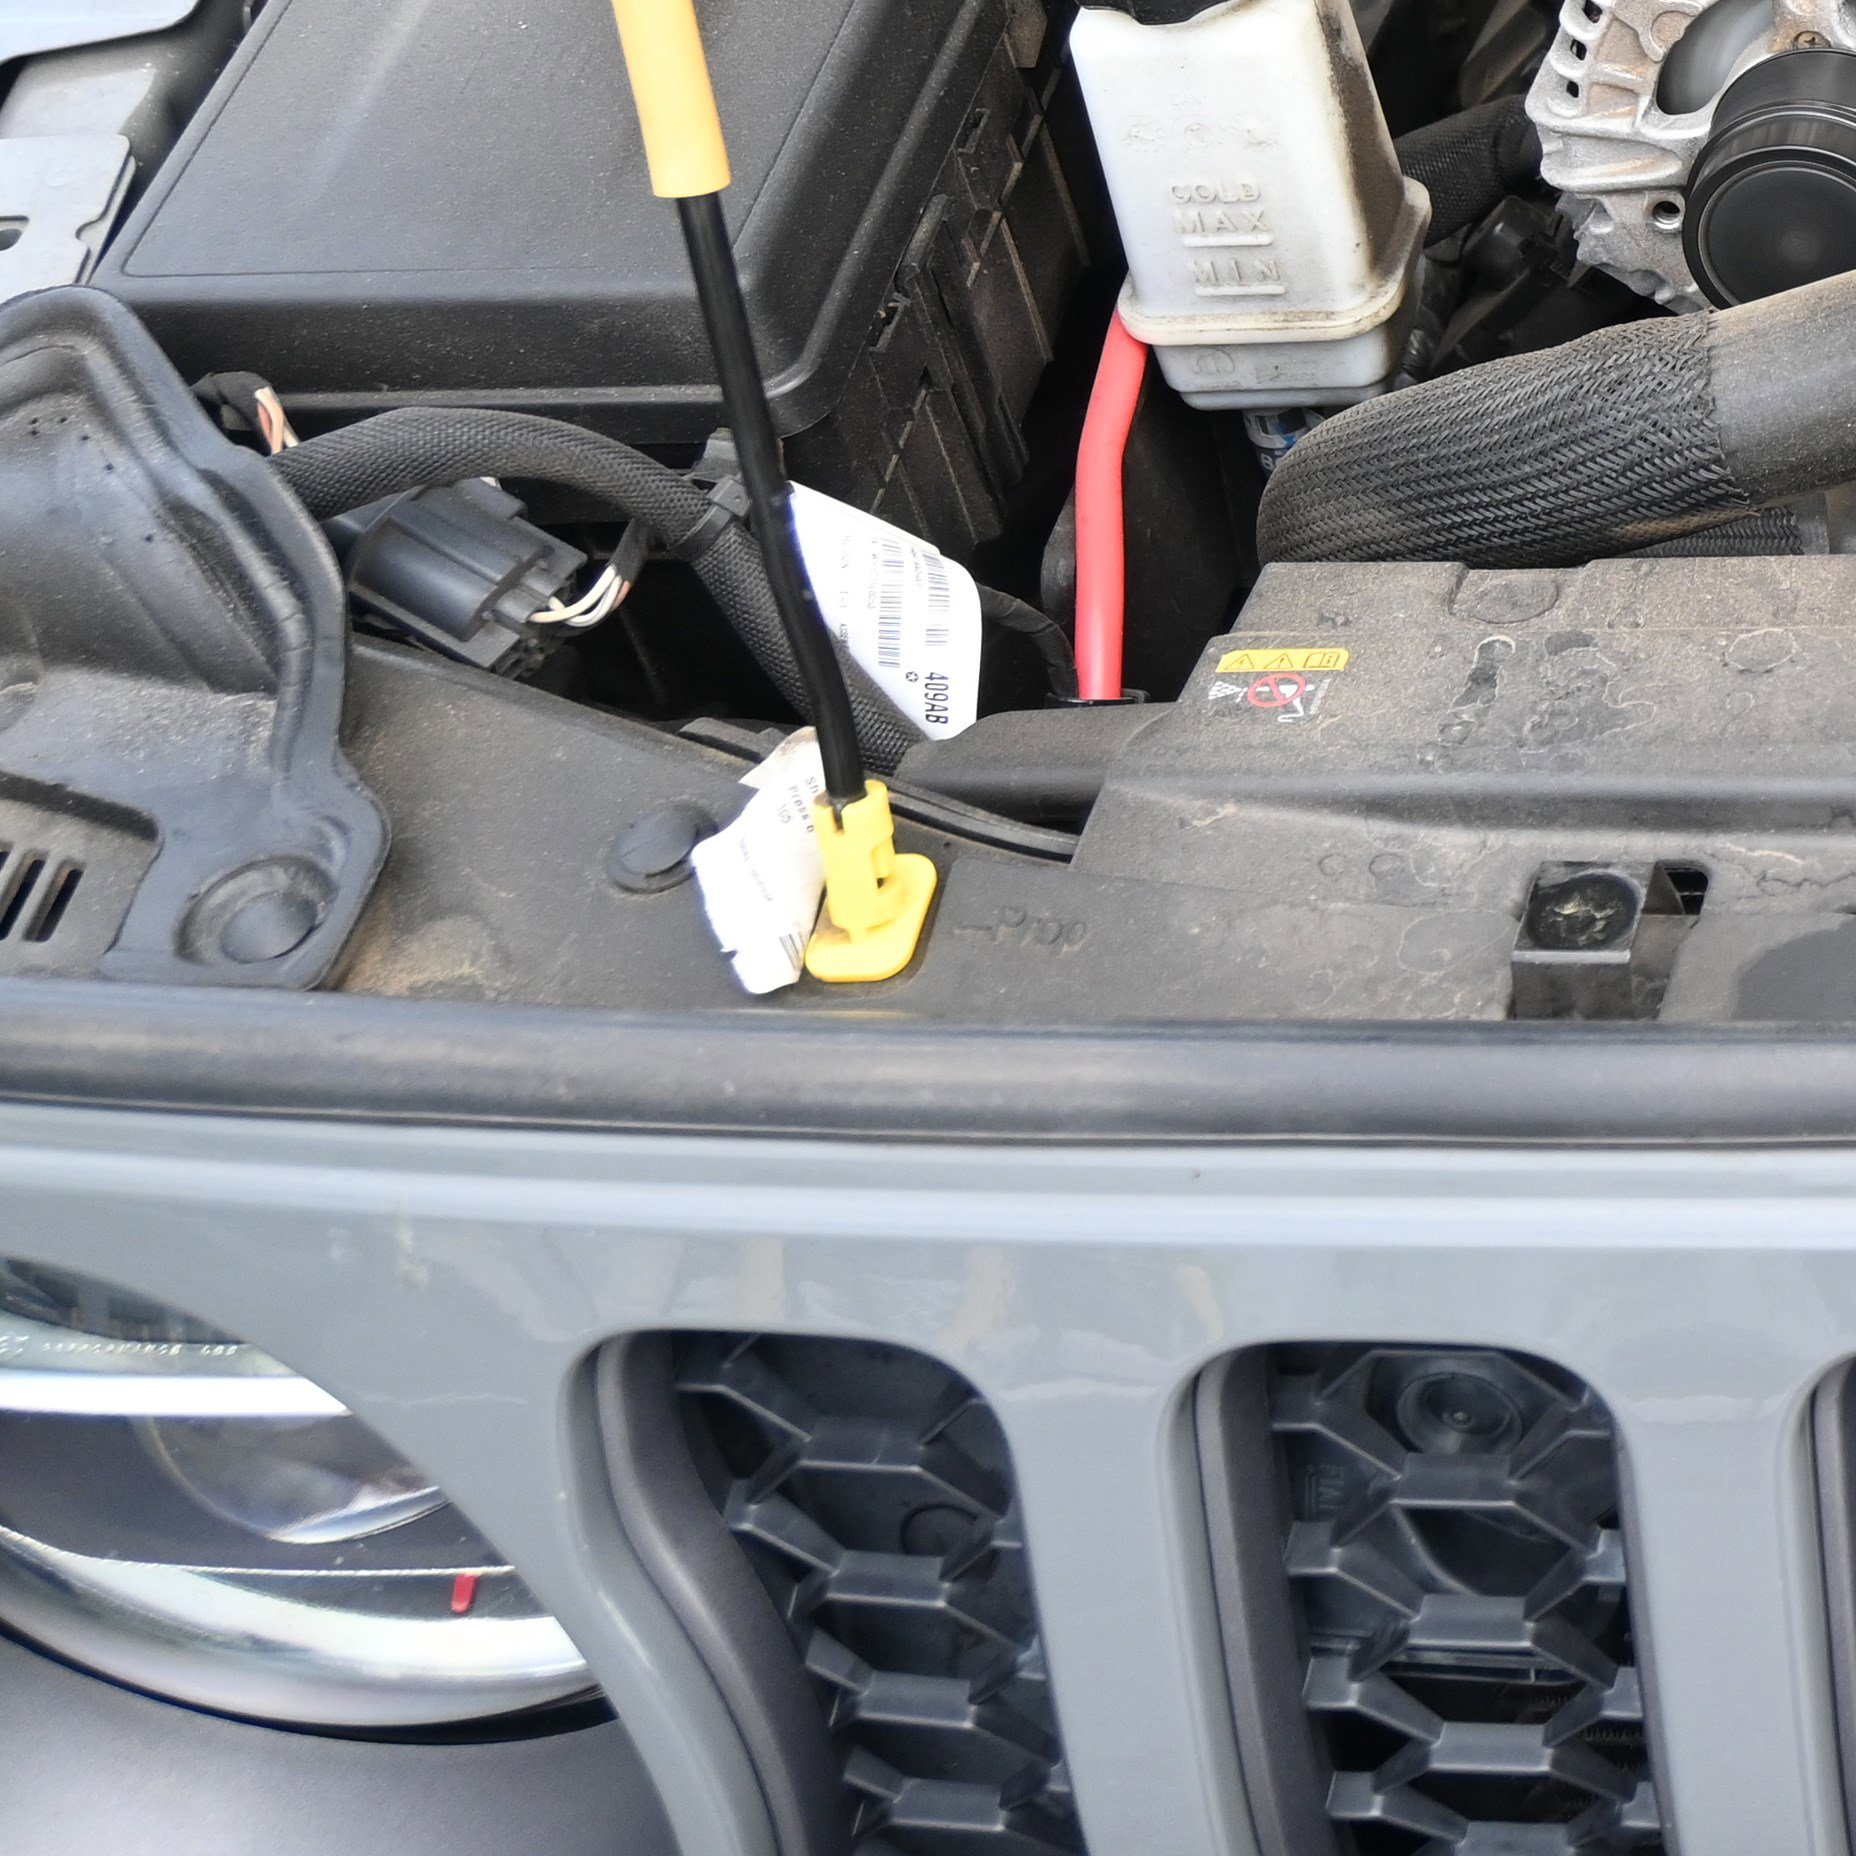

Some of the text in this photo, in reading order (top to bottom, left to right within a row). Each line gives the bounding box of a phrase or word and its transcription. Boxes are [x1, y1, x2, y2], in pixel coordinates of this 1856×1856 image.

[1171, 181, 1261, 204] COLD
[1174, 208, 1271, 234] MAX
[1188, 258, 1283, 284] MIN
[924, 671, 949, 724] 409AB
